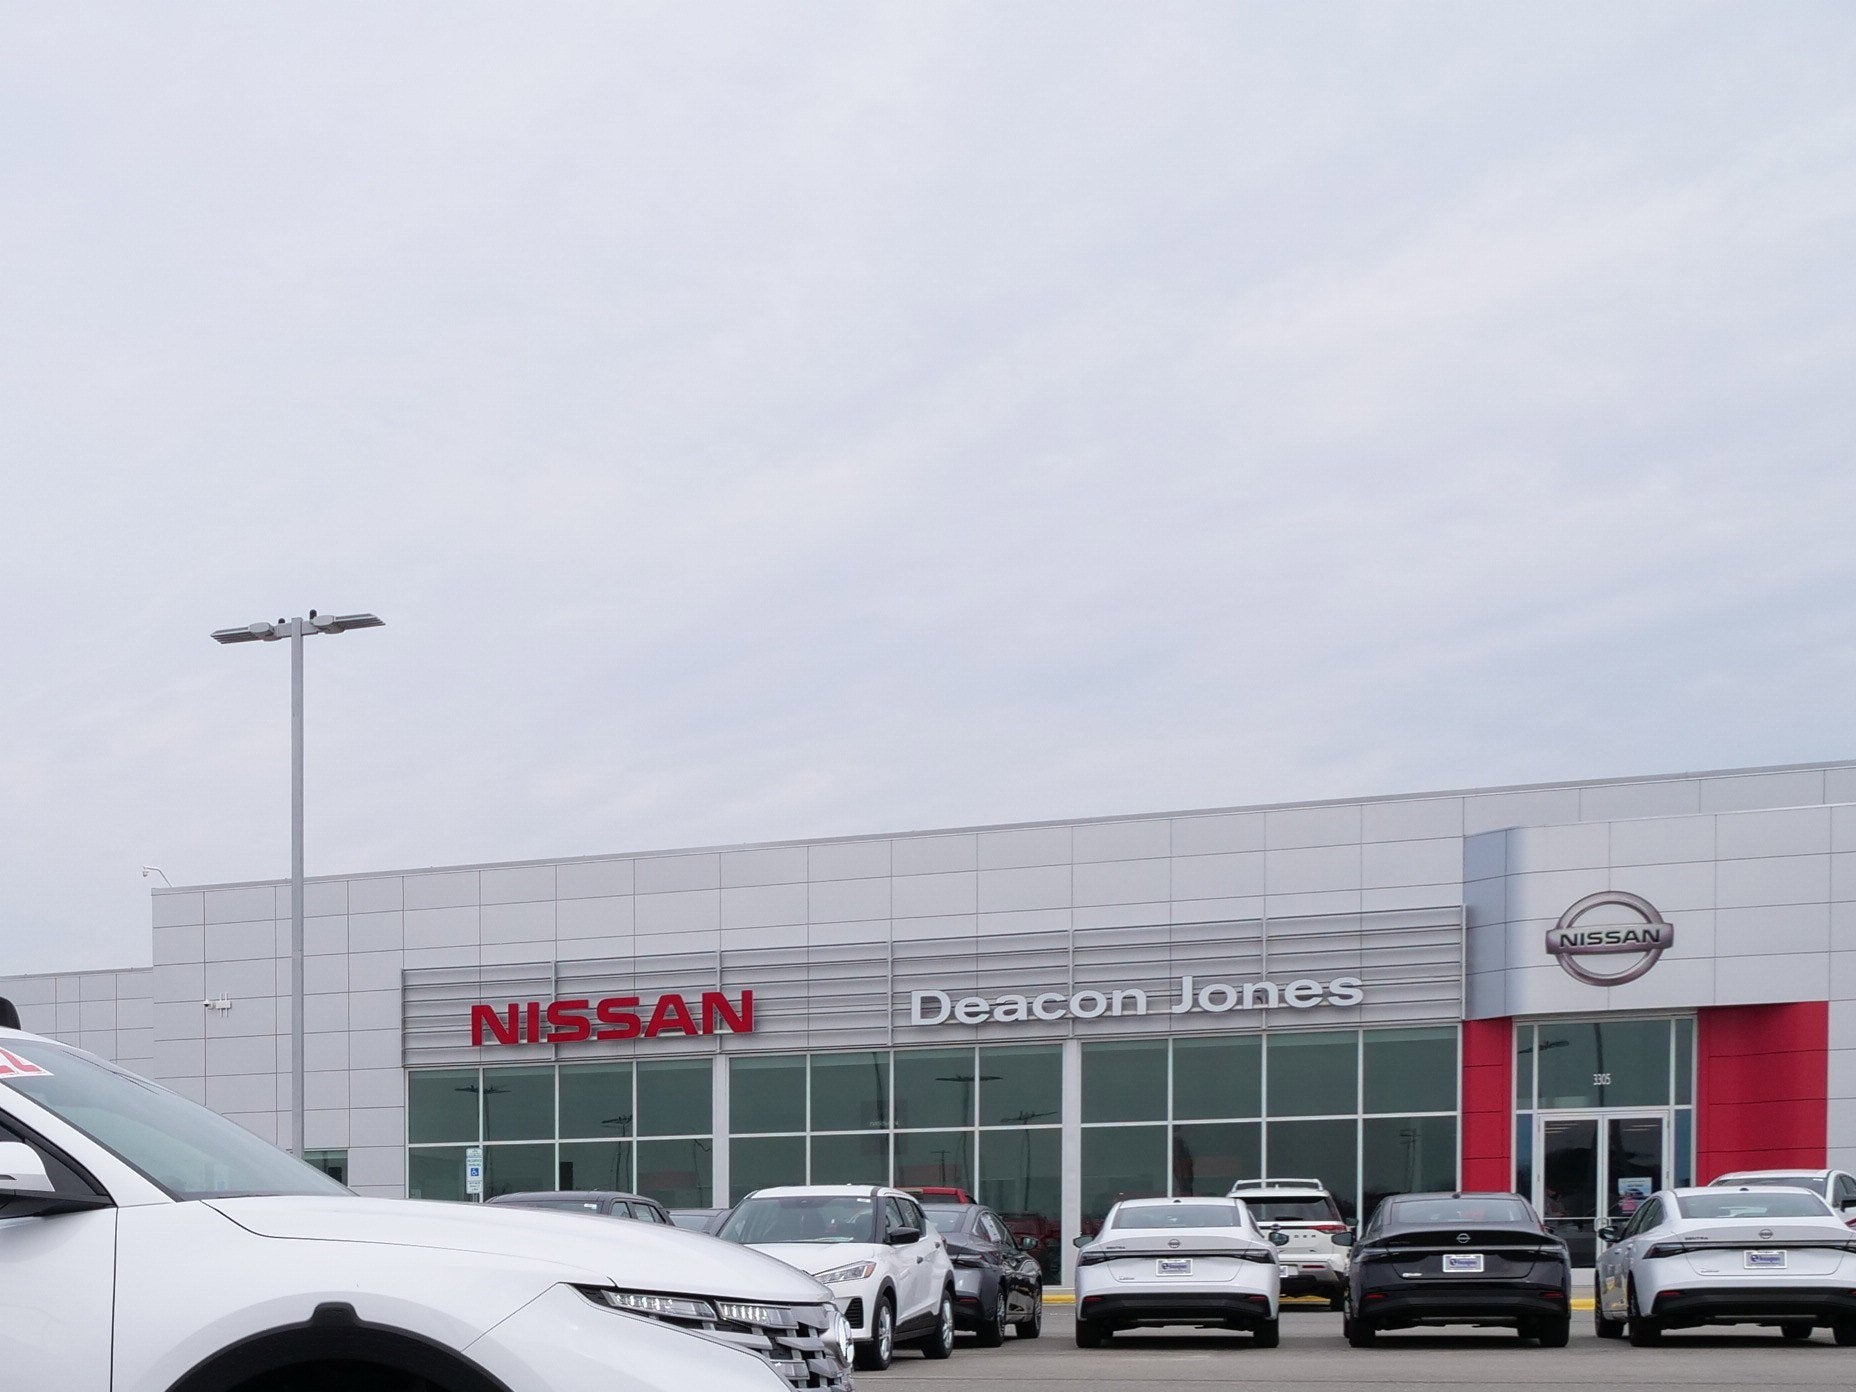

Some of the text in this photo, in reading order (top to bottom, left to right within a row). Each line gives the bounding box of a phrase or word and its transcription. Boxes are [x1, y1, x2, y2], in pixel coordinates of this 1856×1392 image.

[1559, 928, 1661, 948] NISSAN
[471, 989, 755, 1047] NISSAN
[910, 975, 1365, 1027] Deacon Jones
[1592, 1073, 1611, 1086] 3305
